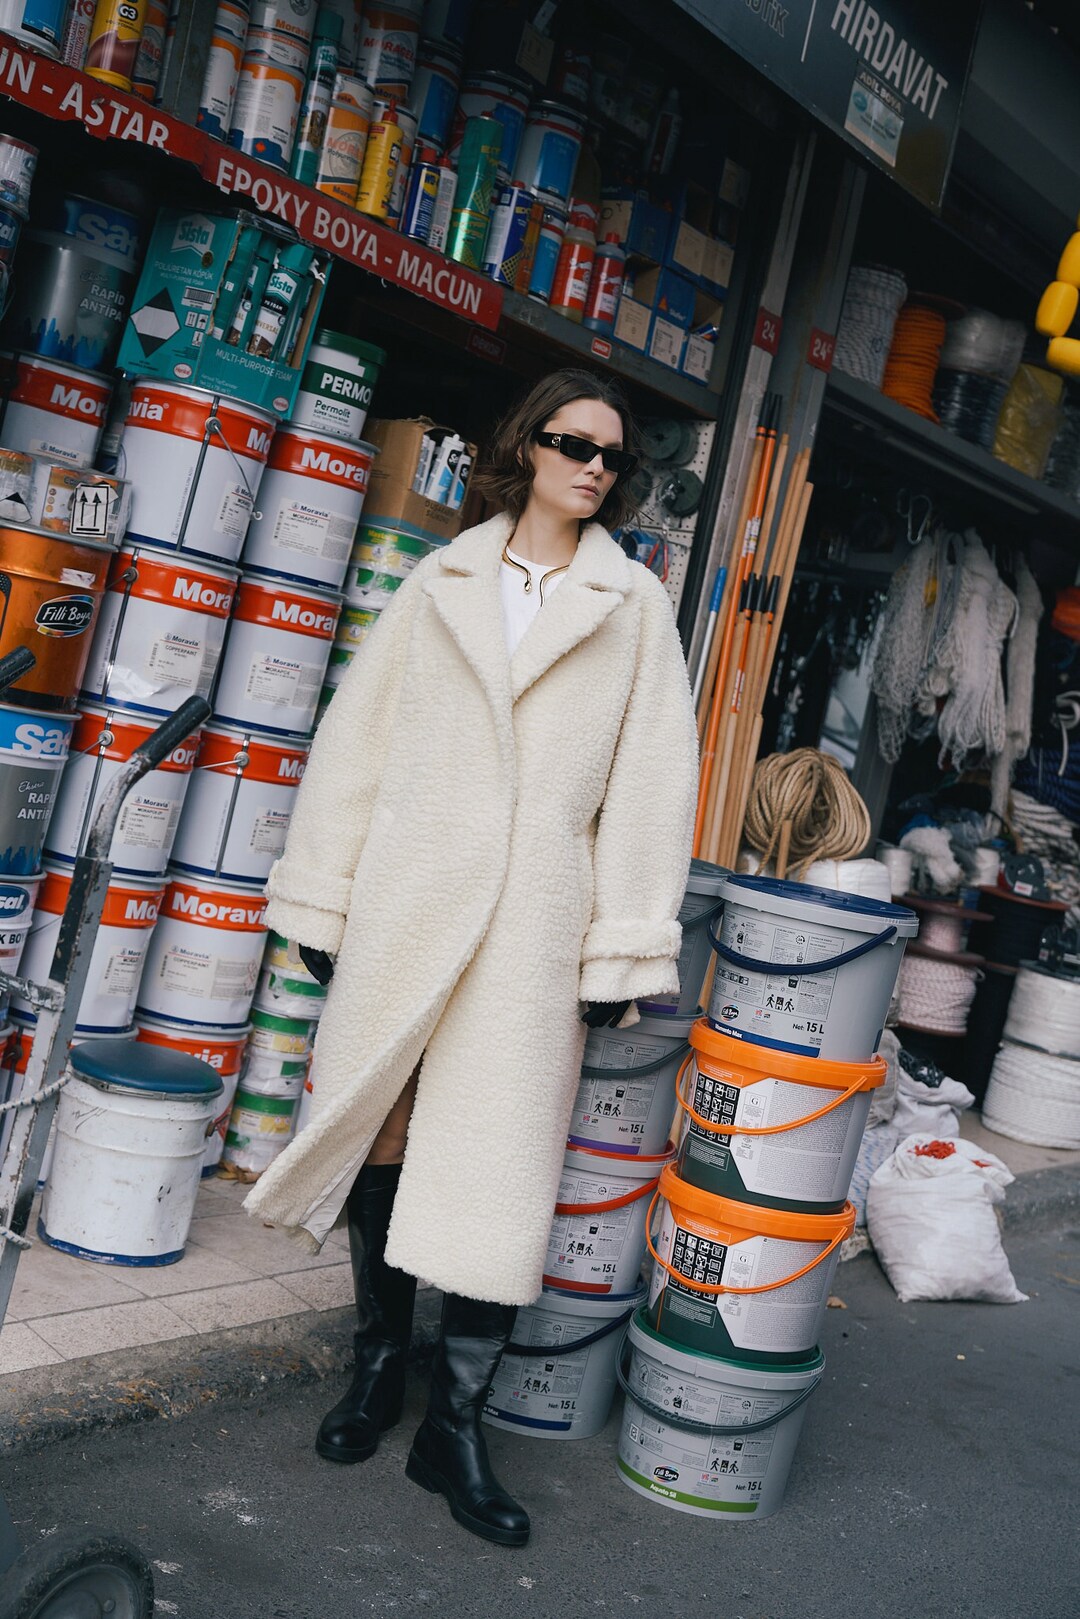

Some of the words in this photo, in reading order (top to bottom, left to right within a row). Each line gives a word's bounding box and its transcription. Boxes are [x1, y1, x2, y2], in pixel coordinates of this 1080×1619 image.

[117, 3, 139, 21] G3
[830, 0, 949, 120] HIRDAVAT
[58, 81, 170, 150] ASTAR
[178, 222, 210, 246] Sista
[215, 158, 310, 233] EPOXY
[312, 205, 380, 268] BOYA
[396, 249, 483, 315] MACUN
[90, 283, 126, 306] RAPİD
[269, 274, 293, 295] Sista
[761, 319, 777, 343] 24
[215, 348, 275, 378] MULTI-PURPOSE
[320, 372, 373, 405] PERMO
[50, 383, 107, 419] Mor
[314, 399, 352, 420] Permolit
[48, 444, 79, 460] Moravia
[300, 504, 329, 518] Moravia
[172, 576, 233, 611] Mora
[42, 604, 66, 622] Filli
[67, 606, 91, 626] Boya
[271, 599, 336, 633] Mora
[171, 634, 199, 647] Moravia
[272, 657, 300, 669] Moravia
[142, 798, 169, 809] Moravia
[179, 947, 210, 960] Moravia
[805, 1020, 818, 1033] 15
[629, 1123, 641, 1134] 15
[601, 1263, 612, 1273] 15
[559, 1400, 571, 1410] 15
[747, 1480, 758, 1492] 15
